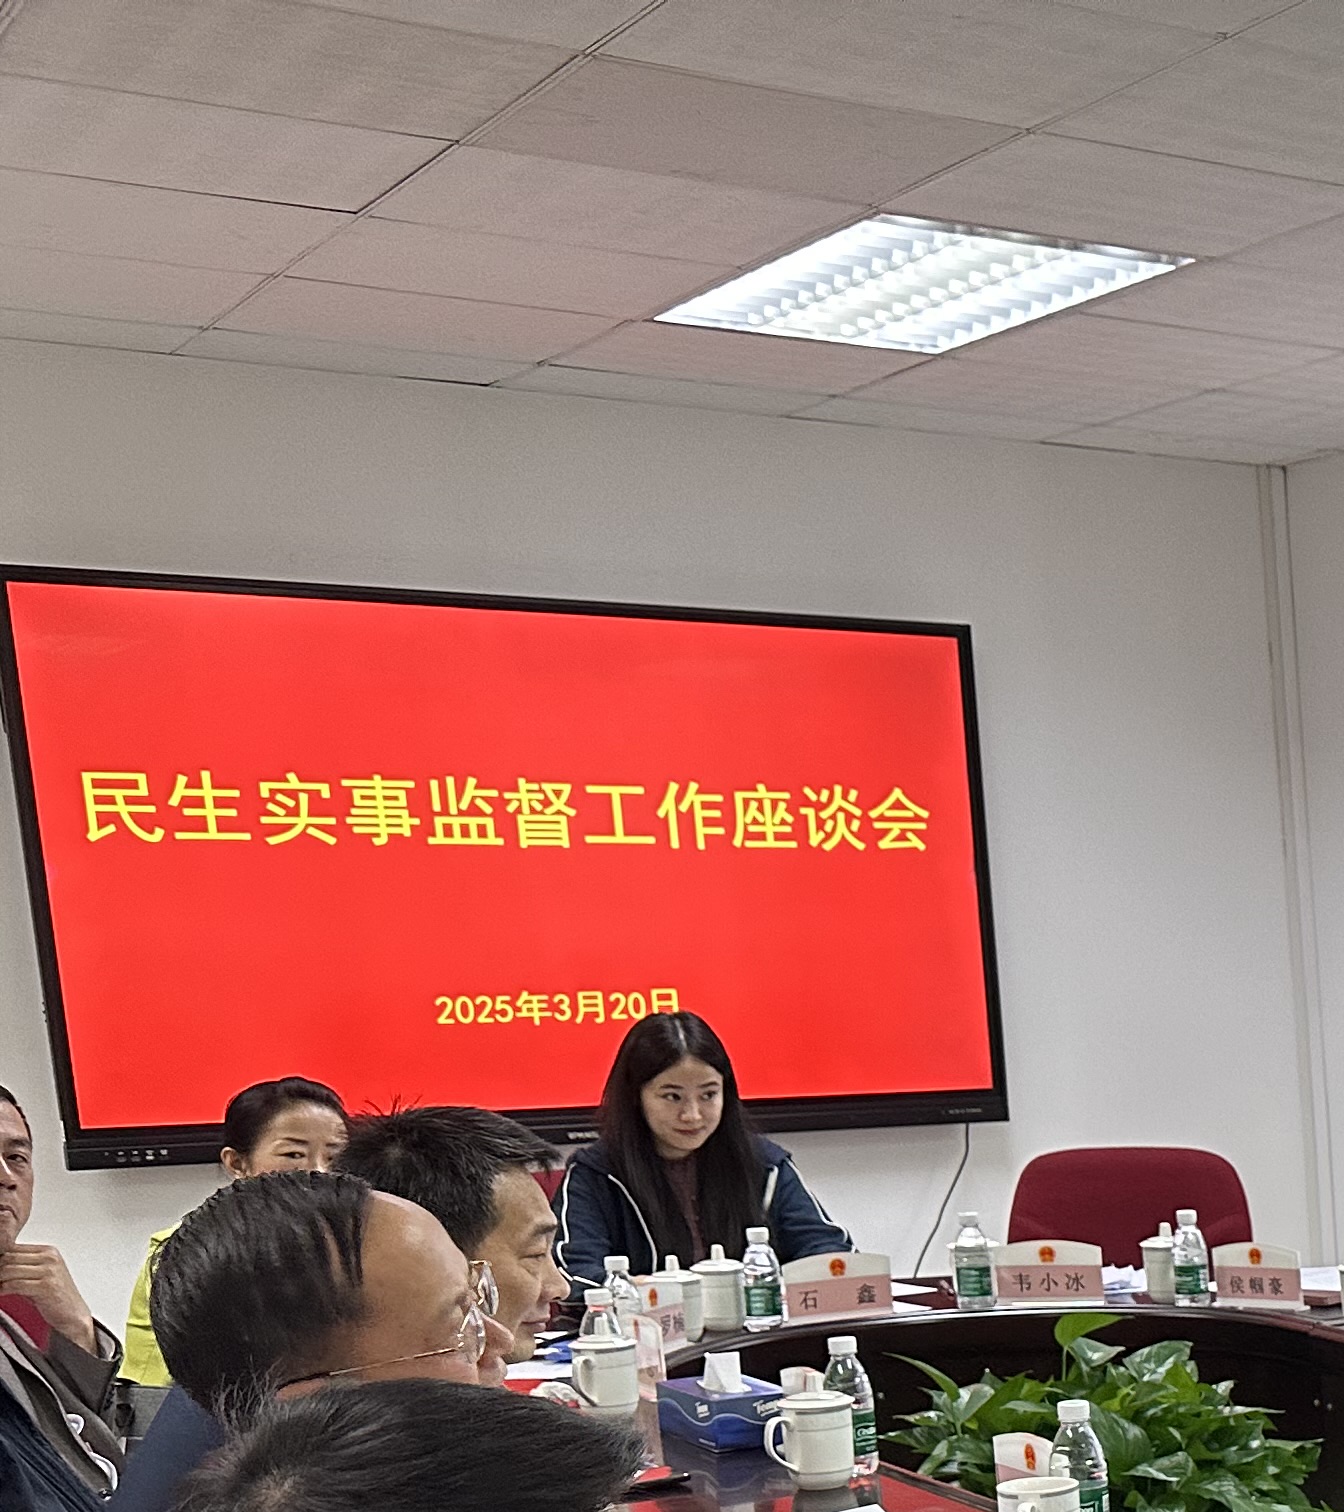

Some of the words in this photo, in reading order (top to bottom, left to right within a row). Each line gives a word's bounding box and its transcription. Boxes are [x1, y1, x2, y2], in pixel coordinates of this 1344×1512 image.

[80, 767, 931, 853] 民生实事监督工作座谈会
[434, 987, 682, 1027] 2025年3月20日
[1012, 1272, 1085, 1293] 韦小冰
